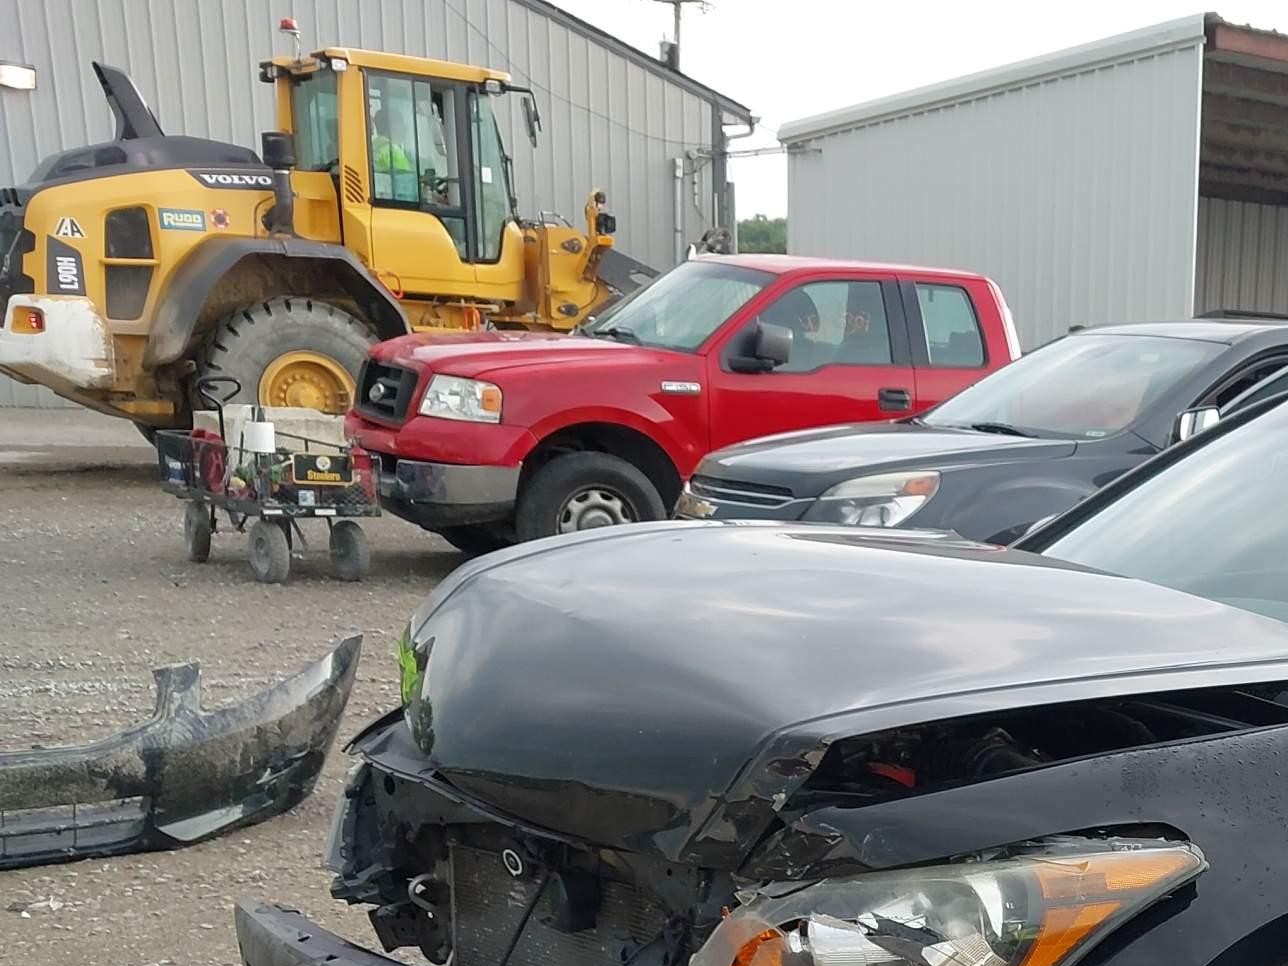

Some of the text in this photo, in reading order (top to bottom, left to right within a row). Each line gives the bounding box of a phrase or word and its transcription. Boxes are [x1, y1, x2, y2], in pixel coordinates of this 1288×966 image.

[200, 174, 272, 185] VOLVO
[162, 212, 202, 226] RUDD
[56, 256, 80, 290] L90H
